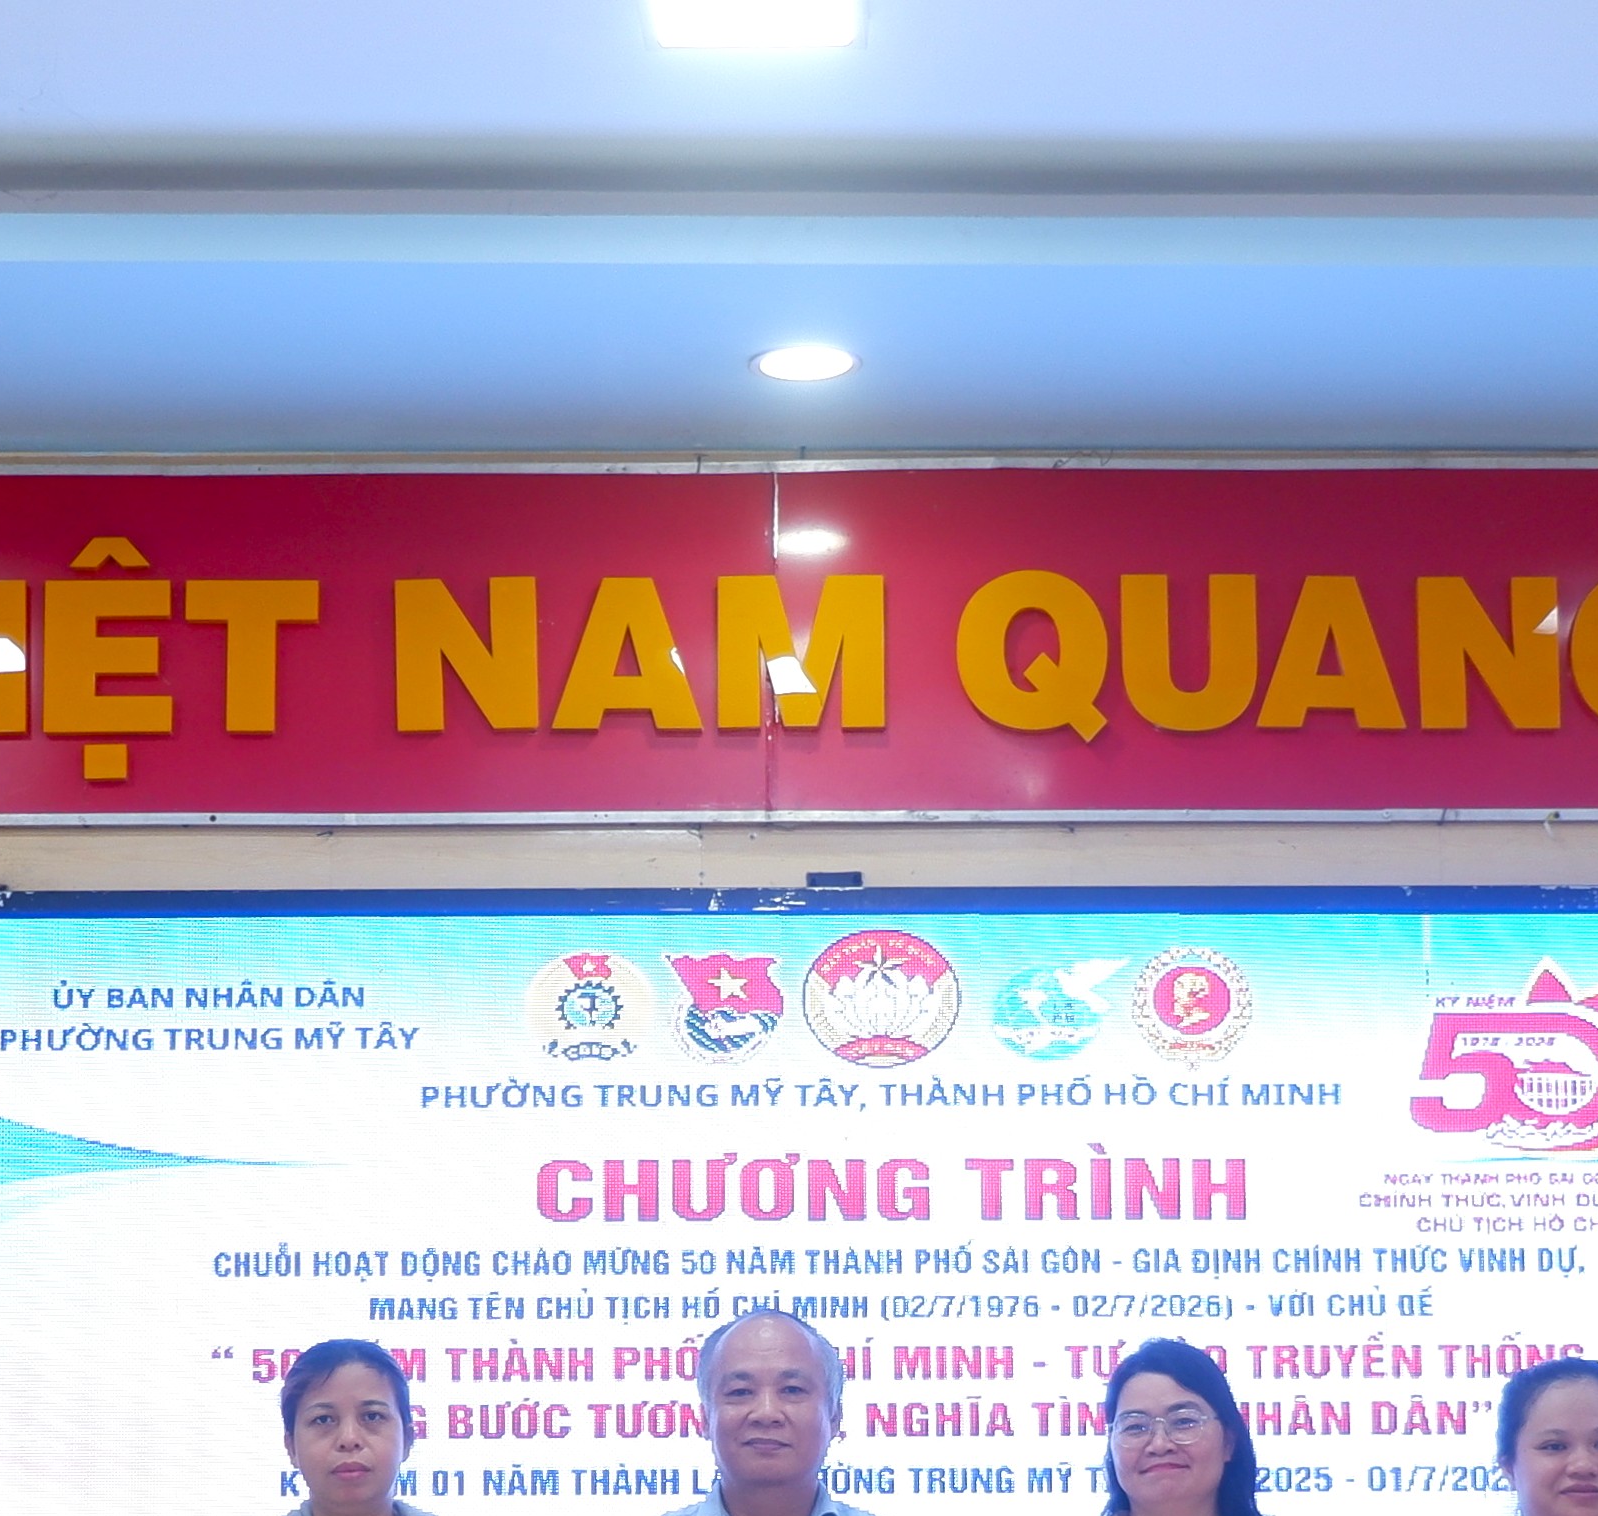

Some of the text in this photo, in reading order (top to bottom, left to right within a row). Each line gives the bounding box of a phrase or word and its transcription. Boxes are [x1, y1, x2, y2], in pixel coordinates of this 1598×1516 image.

[394, 574, 886, 733] NAM
[52, 978, 365, 1010] ỦY BAN NHÂN DÂN
[0, 1021, 420, 1052] PHƯỜNG TRUNG MỸ TÂY
[420, 1074, 1342, 1112] PHƯỜNG TRUNG MỸ TÂY, THÀNH PHỐ HỒ CHÍ MINH
[536, 1142, 1247, 1222] CHƯƠNG TRÌNH
[312, 1249, 389, 1283] HOẠT
[400, 1248, 481, 1283] ĐỘNG
[492, 1247, 572, 1276] CHÀO
[681, 1249, 718, 1275] 50
[726, 1246, 796, 1275] NĂM
[804, 1246, 902, 1275] THÀNH
[914, 1239, 976, 1274] PHỐ
[981, 1245, 1029, 1274] SÀI
[1132, 1247, 1182, 1274] GIA
[1191, 1247, 1261, 1280] ĐỊNH
[1272, 1244, 1361, 1274] CHÍNH
[1372, 1244, 1448, 1273] THỨC
[1458, 1247, 1526, 1273] VINH
[1536, 1245, 1586, 1278] DỰ,
[369, 1296, 458, 1321] MANG
[467, 1291, 525, 1321] TÊN
[536, 1287, 595, 1320] CHỦ
[604, 1296, 671, 1326] TỊCH
[792, 1295, 868, 1320] MINH
[880, 1294, 1039, 1322] (02/7/1976
[1050, 1304, 1060, 1312] -
[1072, 1294, 1233, 1321] 02/7/2026)
[1245, 1303, 1255, 1311] -
[1267, 1288, 1314, 1317] VỚI
[1326, 1285, 1386, 1317] CHỦ
[445, 1338, 594, 1382] THÀNH
[612, 1333, 704, 1381] PHỐ
[893, 1345, 1014, 1380] MINH
[447, 1398, 572, 1440] BƯỚC
[587, 1400, 704, 1439] TƯƠN
[865, 1396, 1015, 1437] NGHĨA
[1031, 1396, 1108, 1437] TÌN
[432, 1470, 465, 1497] 01
[483, 1463, 560, 1496] NĂM
[571, 1463, 680, 1496] THÀNH
[906, 1466, 1015, 1494] TRUNG
[1027, 1461, 1072, 1494] MỸ
